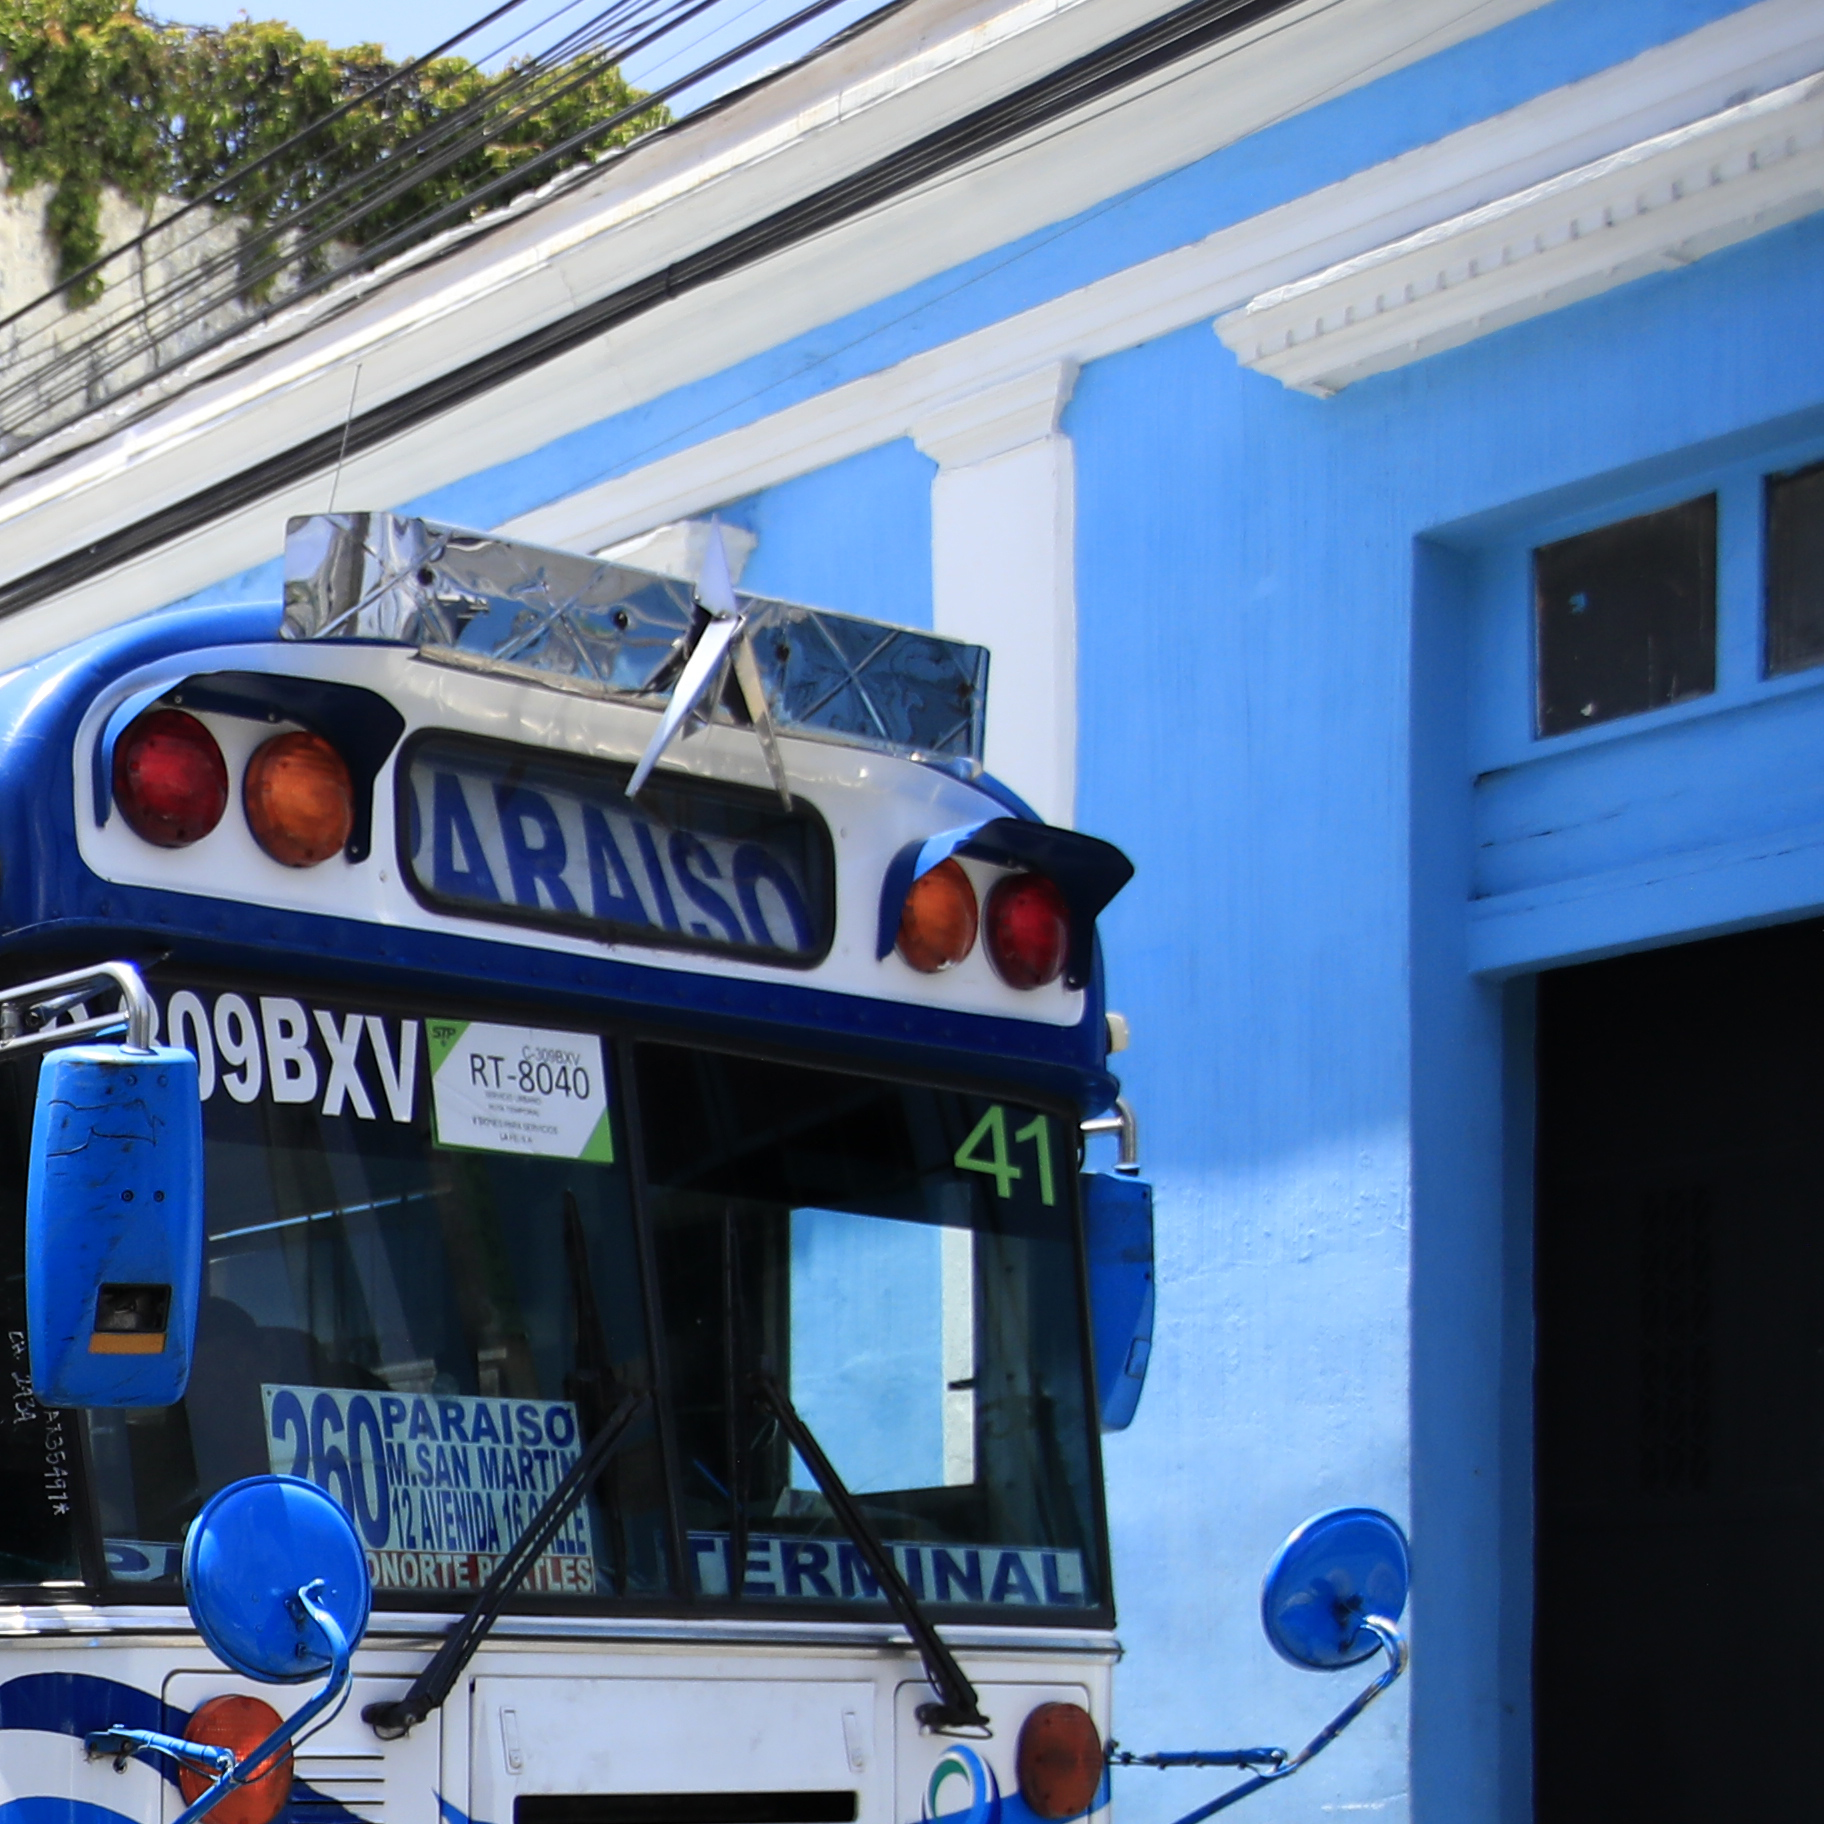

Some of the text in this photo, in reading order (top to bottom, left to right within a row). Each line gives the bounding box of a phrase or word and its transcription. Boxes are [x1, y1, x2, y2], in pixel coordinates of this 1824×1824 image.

[469, 1053, 590, 1100] RT-8040
[954, 1104, 1055, 1206] 41
[379, 1396, 575, 1449] PARAISO
[392, 1491, 416, 1550] 12
[419, 1491, 499, 1552] AVENIDA
